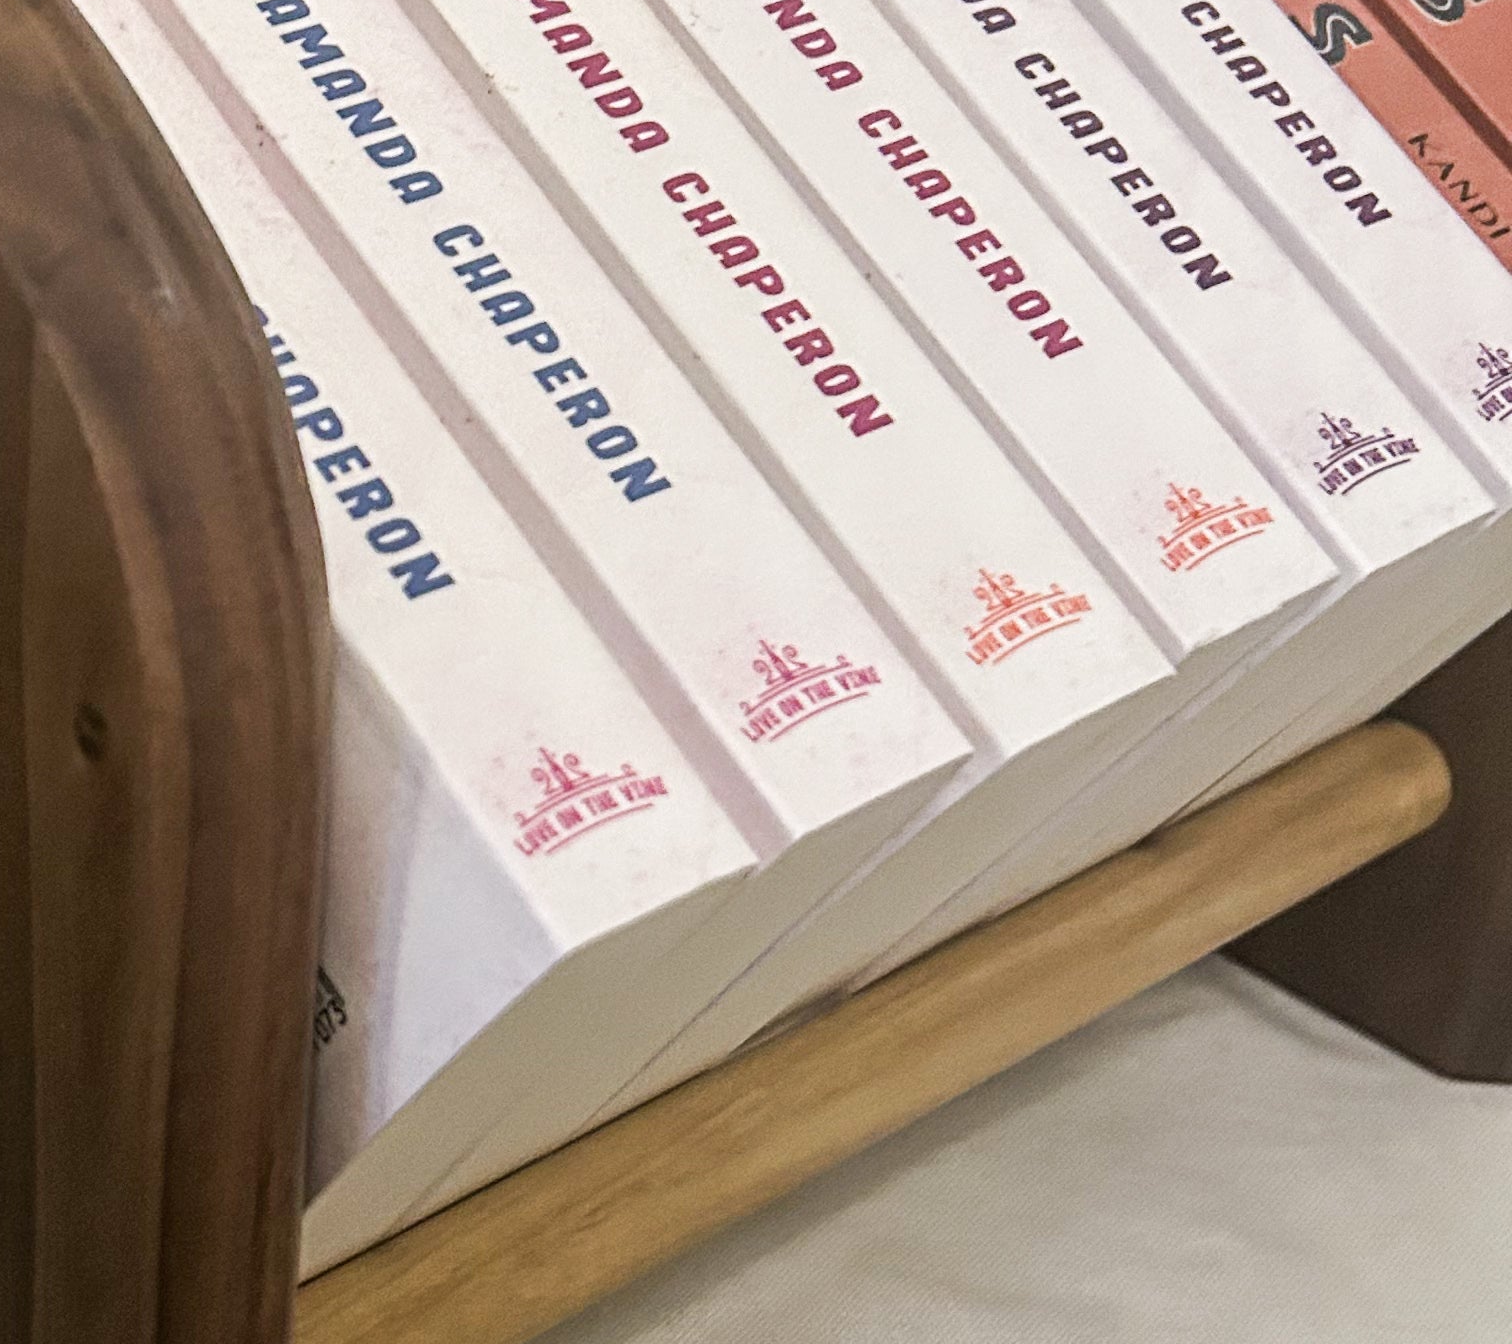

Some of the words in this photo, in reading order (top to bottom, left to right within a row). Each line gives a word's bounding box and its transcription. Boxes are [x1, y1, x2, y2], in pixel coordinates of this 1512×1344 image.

[1013, 52, 1234, 293] CHAPERON
[1181, 1, 1393, 229] CHAPERON
[1407, 133, 1510, 239] KANDI
[662, 171, 896, 439] CHAPERON
[858, 109, 1084, 361] CHAPERON
[431, 223, 673, 504] CHAPERON
[252, 303, 456, 601] APERON
[1207, 518, 1237, 538] THE
[1358, 448, 1387, 467] THE
[801, 680, 836, 704] THE
[1021, 607, 1051, 628] THE
[581, 790, 618, 816] THE
